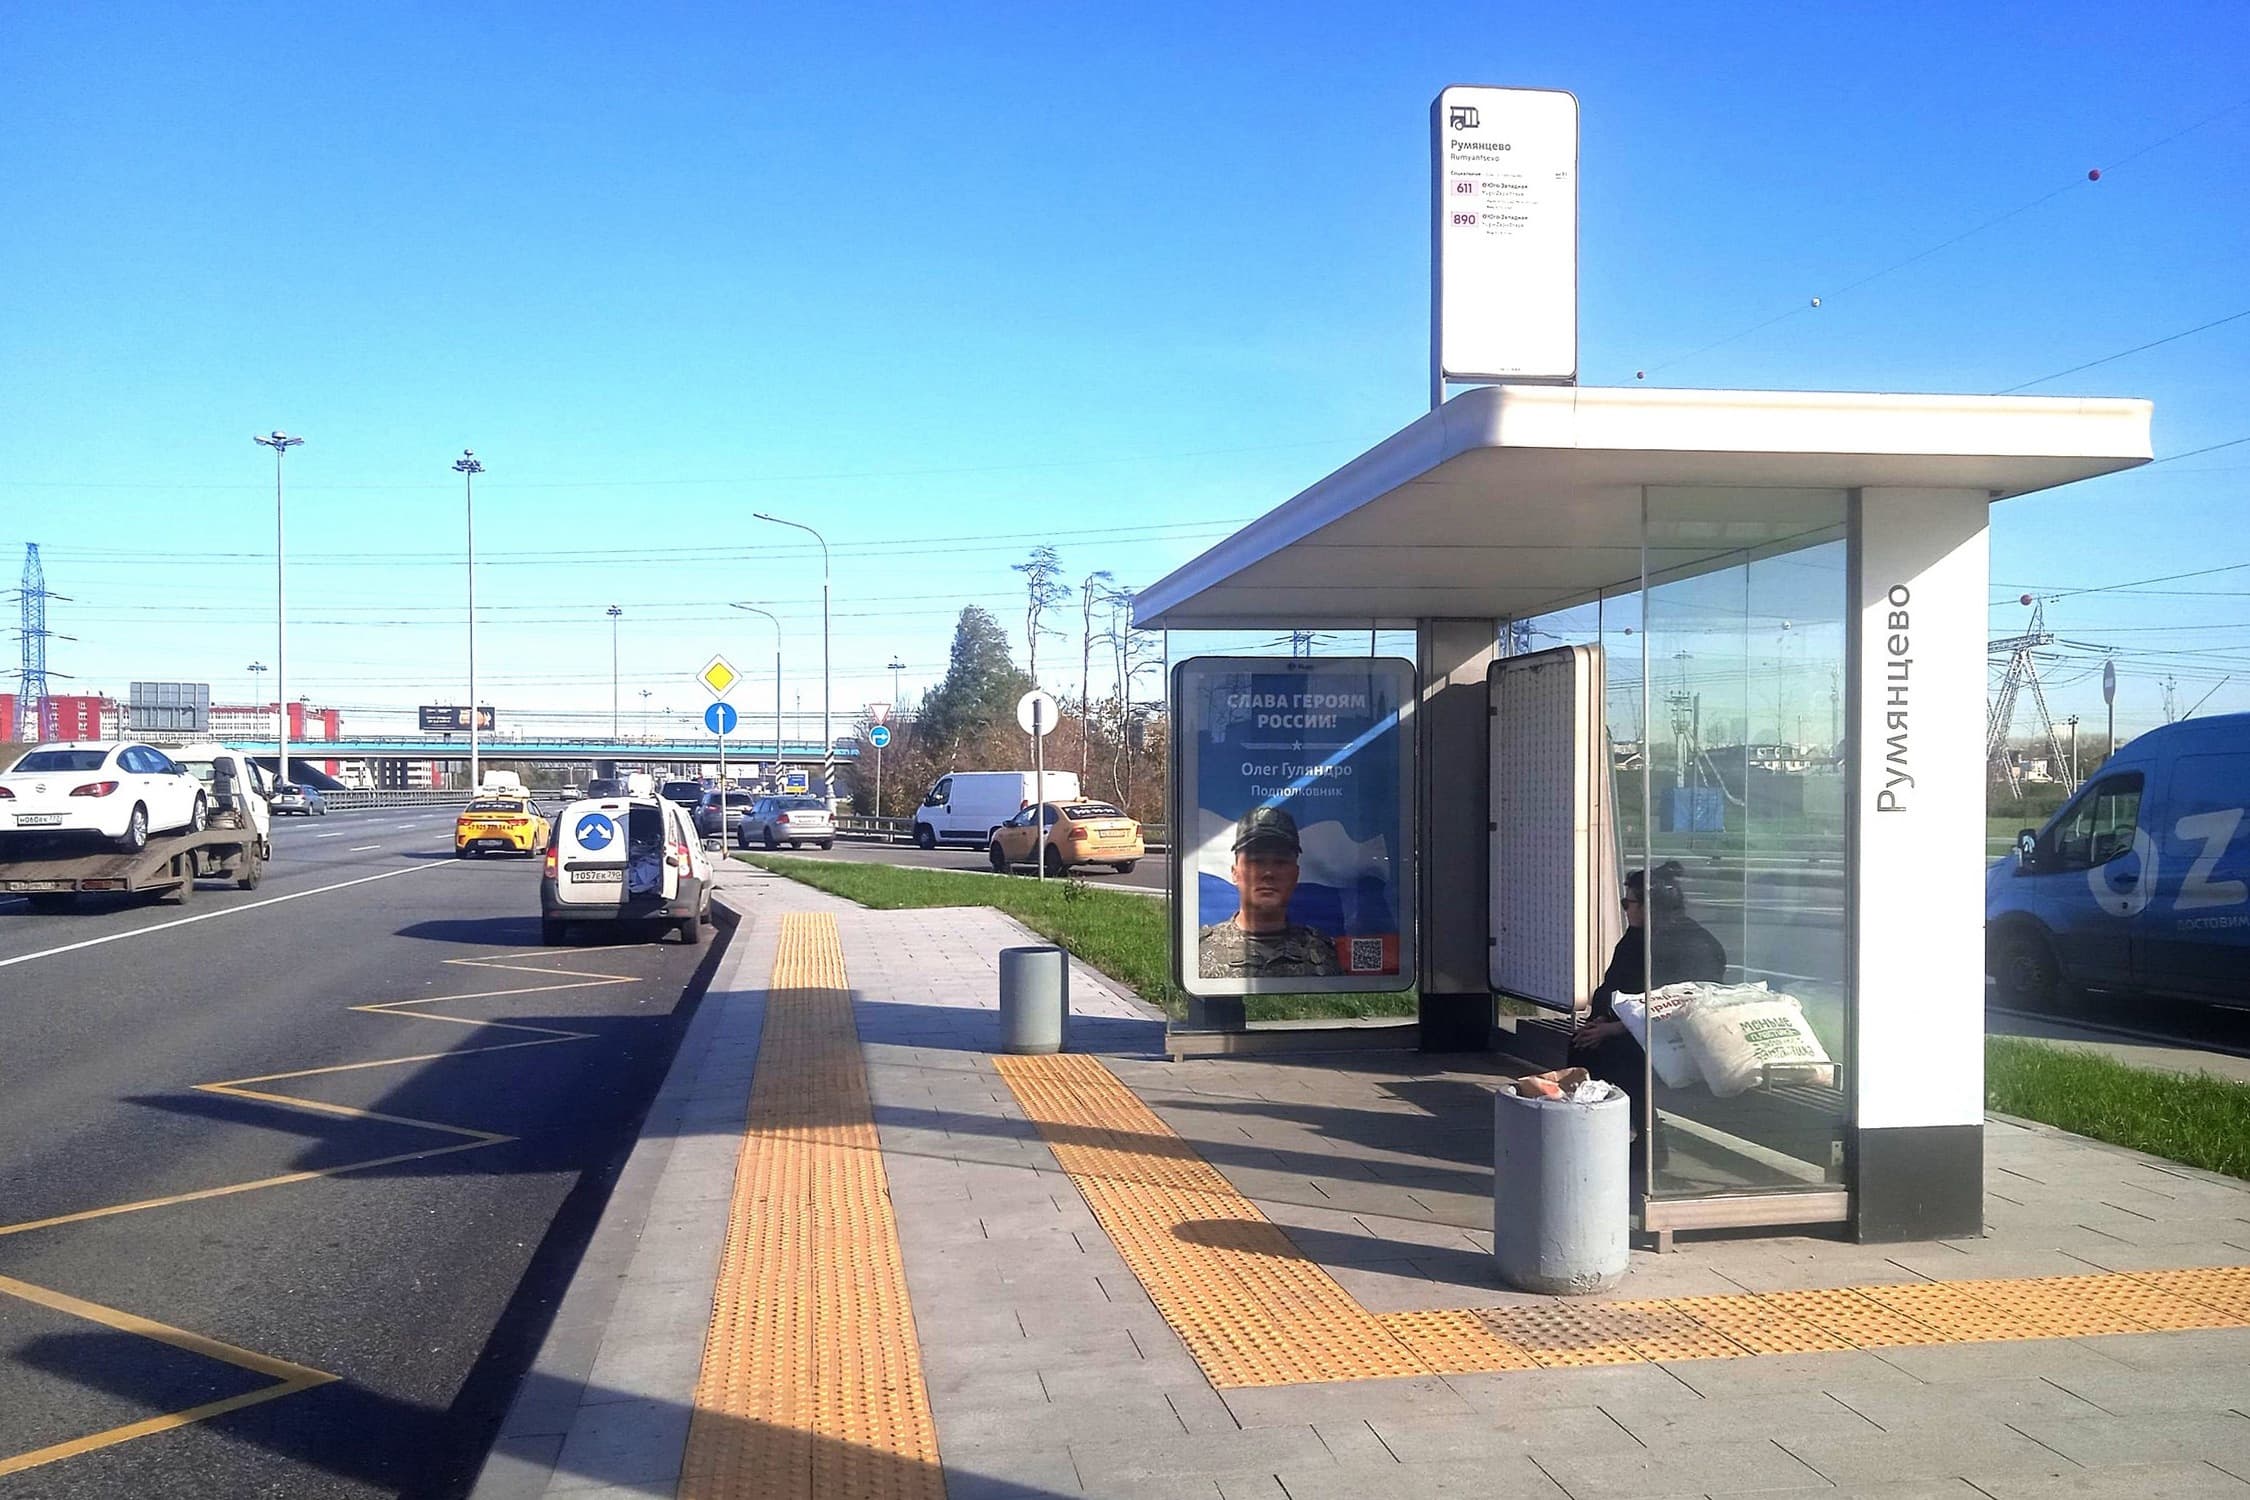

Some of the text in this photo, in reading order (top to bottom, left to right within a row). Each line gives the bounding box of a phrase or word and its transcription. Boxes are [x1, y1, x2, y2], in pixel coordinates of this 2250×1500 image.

[1450, 139, 1512, 151] Румянцево
[1456, 183, 1473, 193] 611
[1453, 214, 1476, 225] 890
[1226, 694, 1366, 709] СЛАВА ГЕРОЯМ
[1877, 584, 1914, 812] Румянцево
[1257, 714, 1337, 729] РОССИИ!
[1241, 762, 1353, 779] Олег Гуляндро
[1251, 784, 1343, 797] Подполковник
